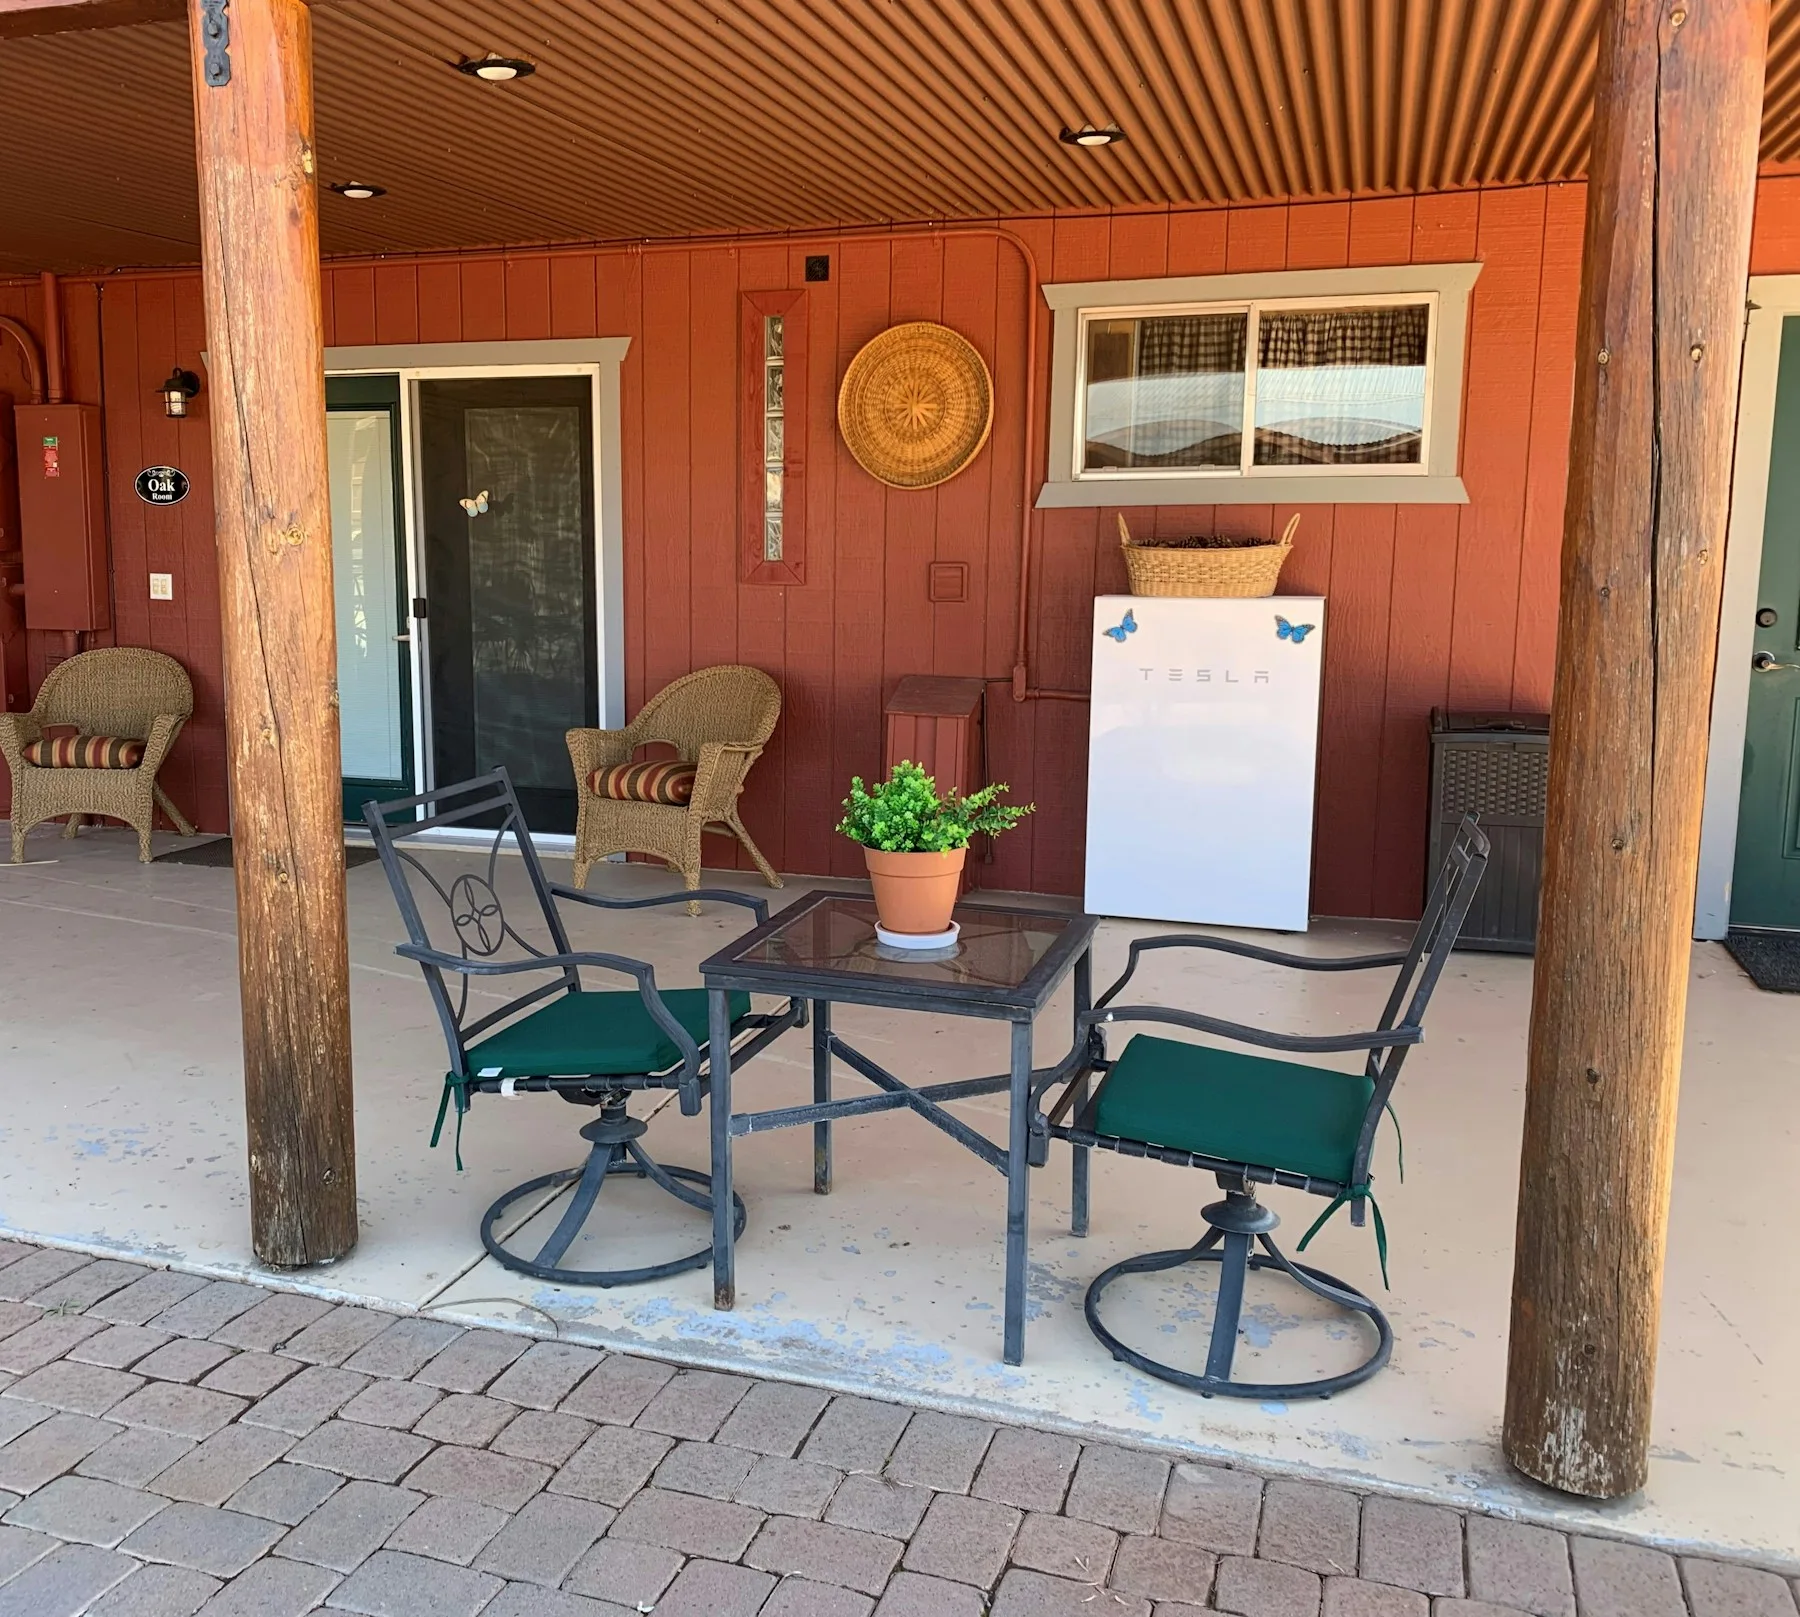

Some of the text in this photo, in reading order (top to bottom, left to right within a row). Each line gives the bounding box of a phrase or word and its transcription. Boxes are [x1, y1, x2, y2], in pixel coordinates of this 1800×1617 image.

[148, 478, 175, 492] Oak
[152, 493, 172, 501] Room
[1139, 667, 1269, 683] TESLA
